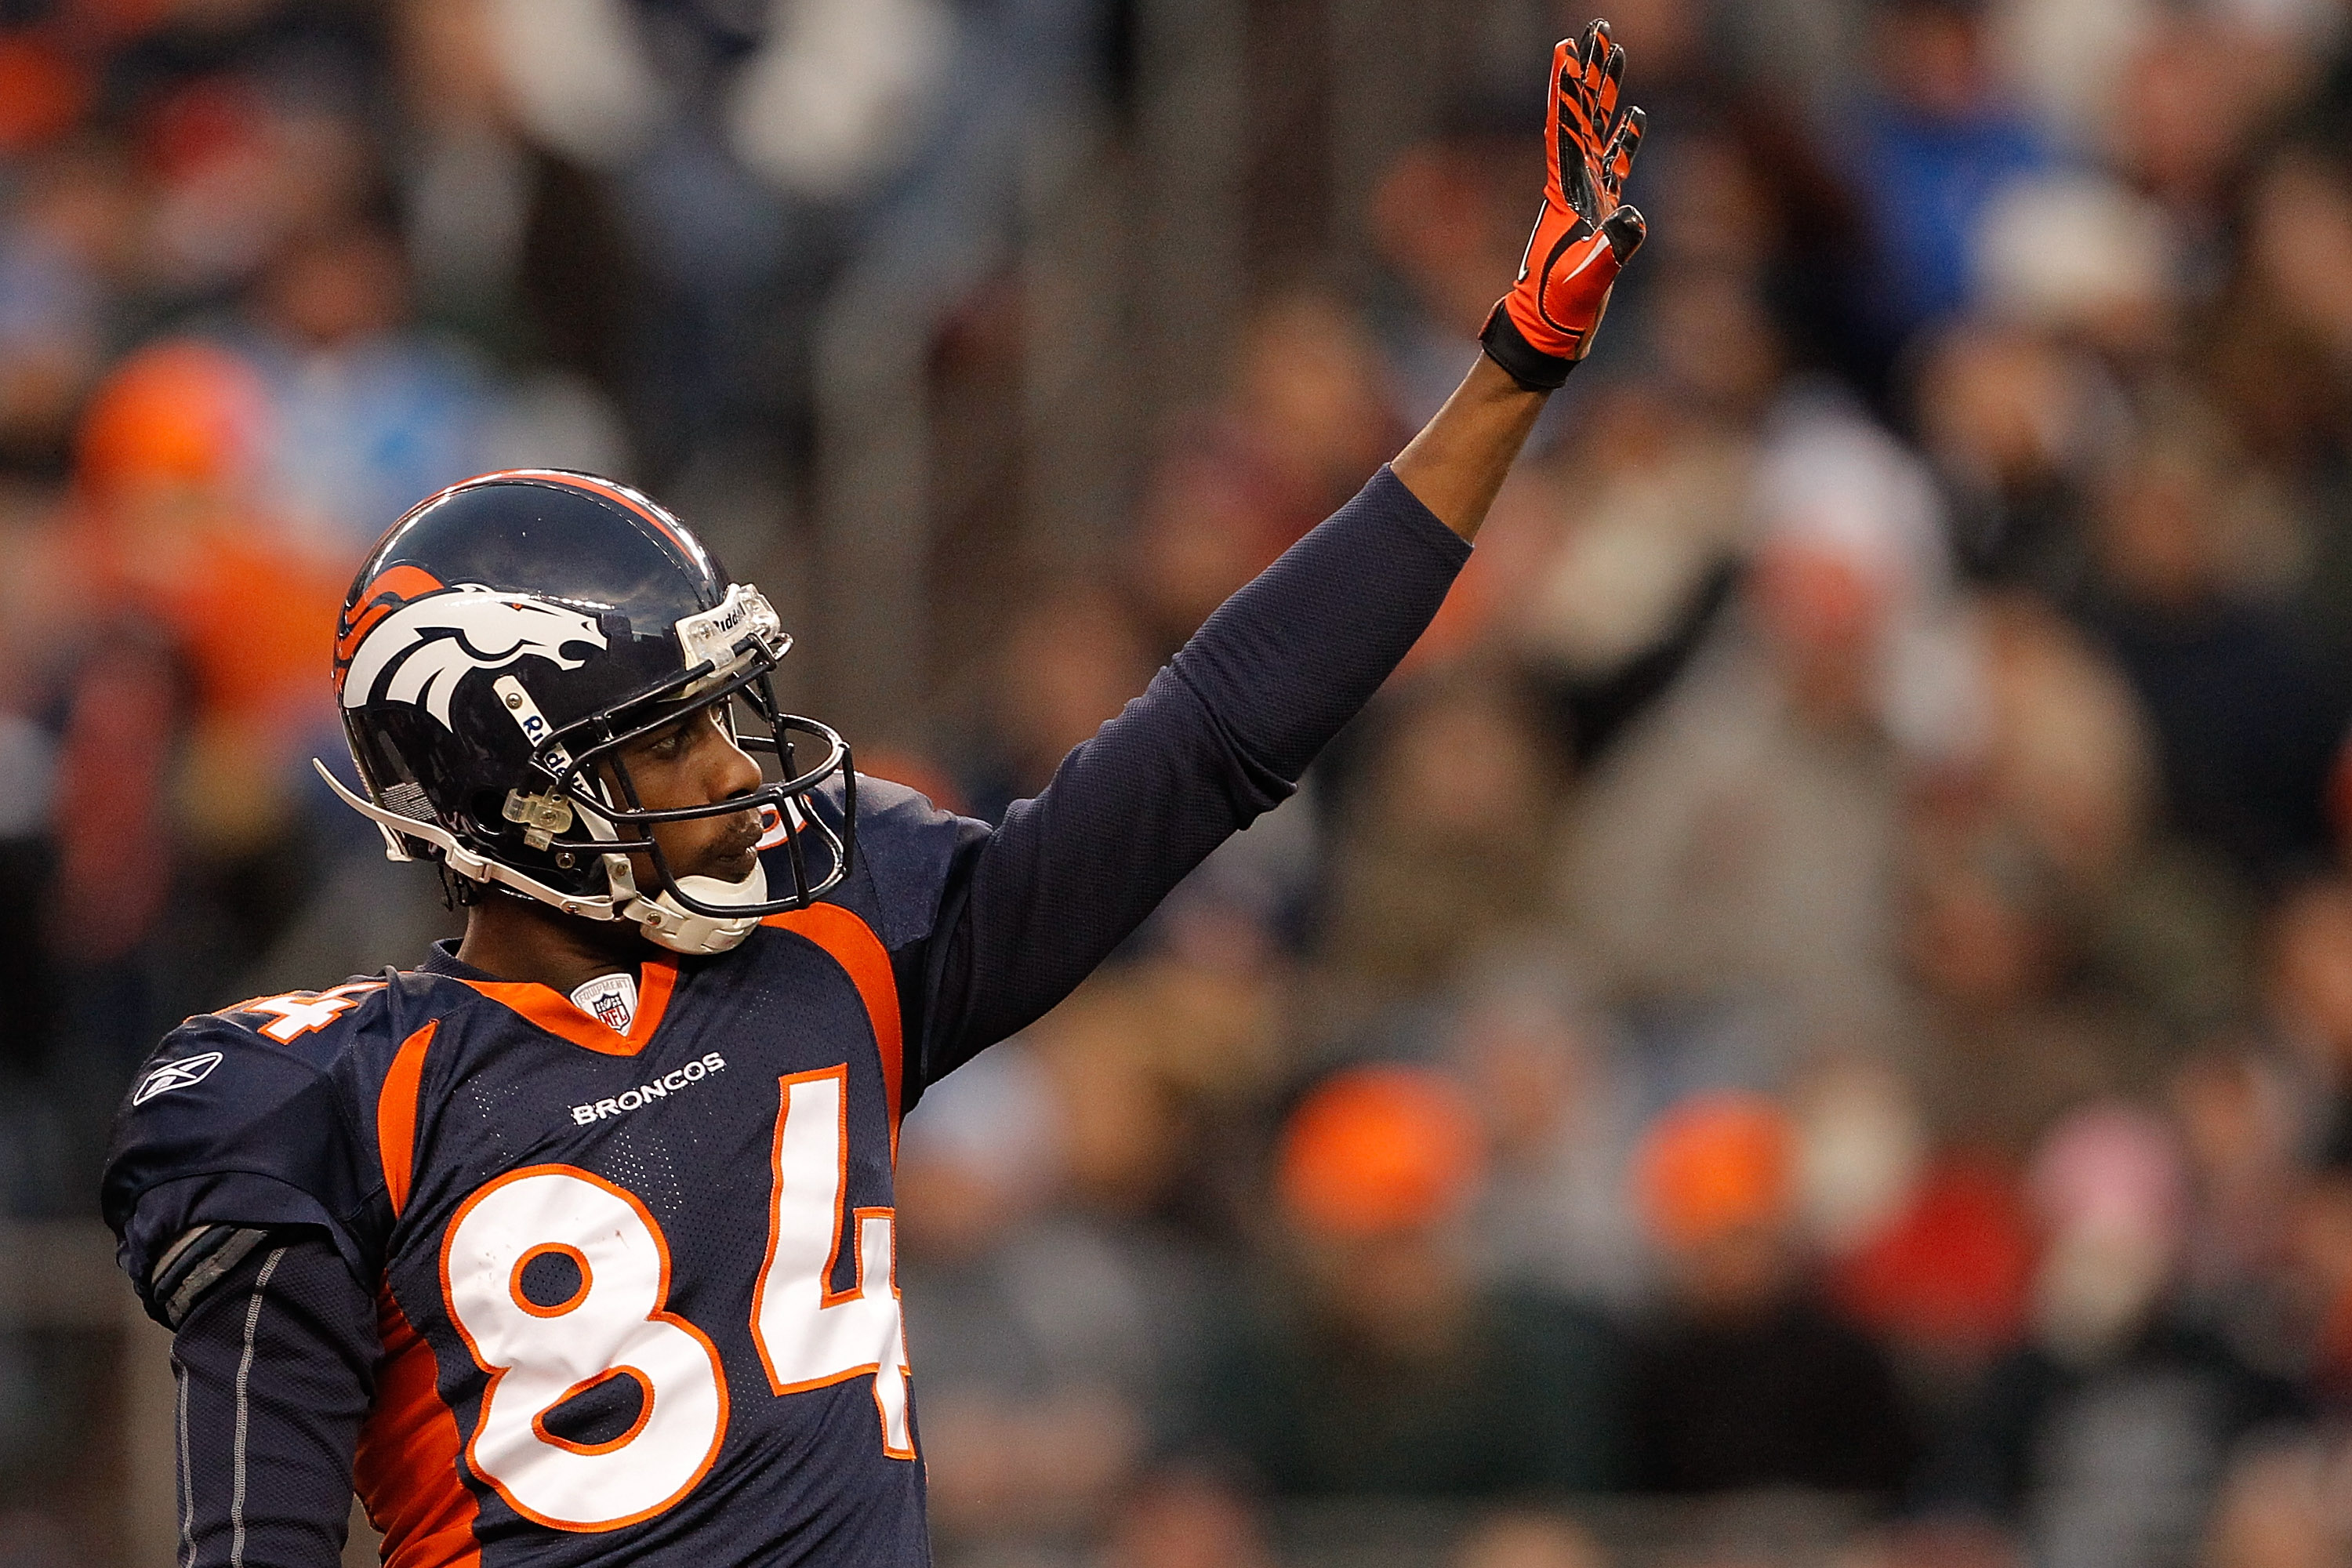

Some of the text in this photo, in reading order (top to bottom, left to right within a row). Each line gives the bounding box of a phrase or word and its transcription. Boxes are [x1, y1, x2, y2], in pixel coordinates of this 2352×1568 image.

[712, 601, 746, 631] iddl
[578, 979, 628, 1004] EQUIPMENT
[598, 1007, 628, 1026] NFL
[572, 1051, 726, 1126] BRONCOS
[439, 1063, 916, 1532] 84
